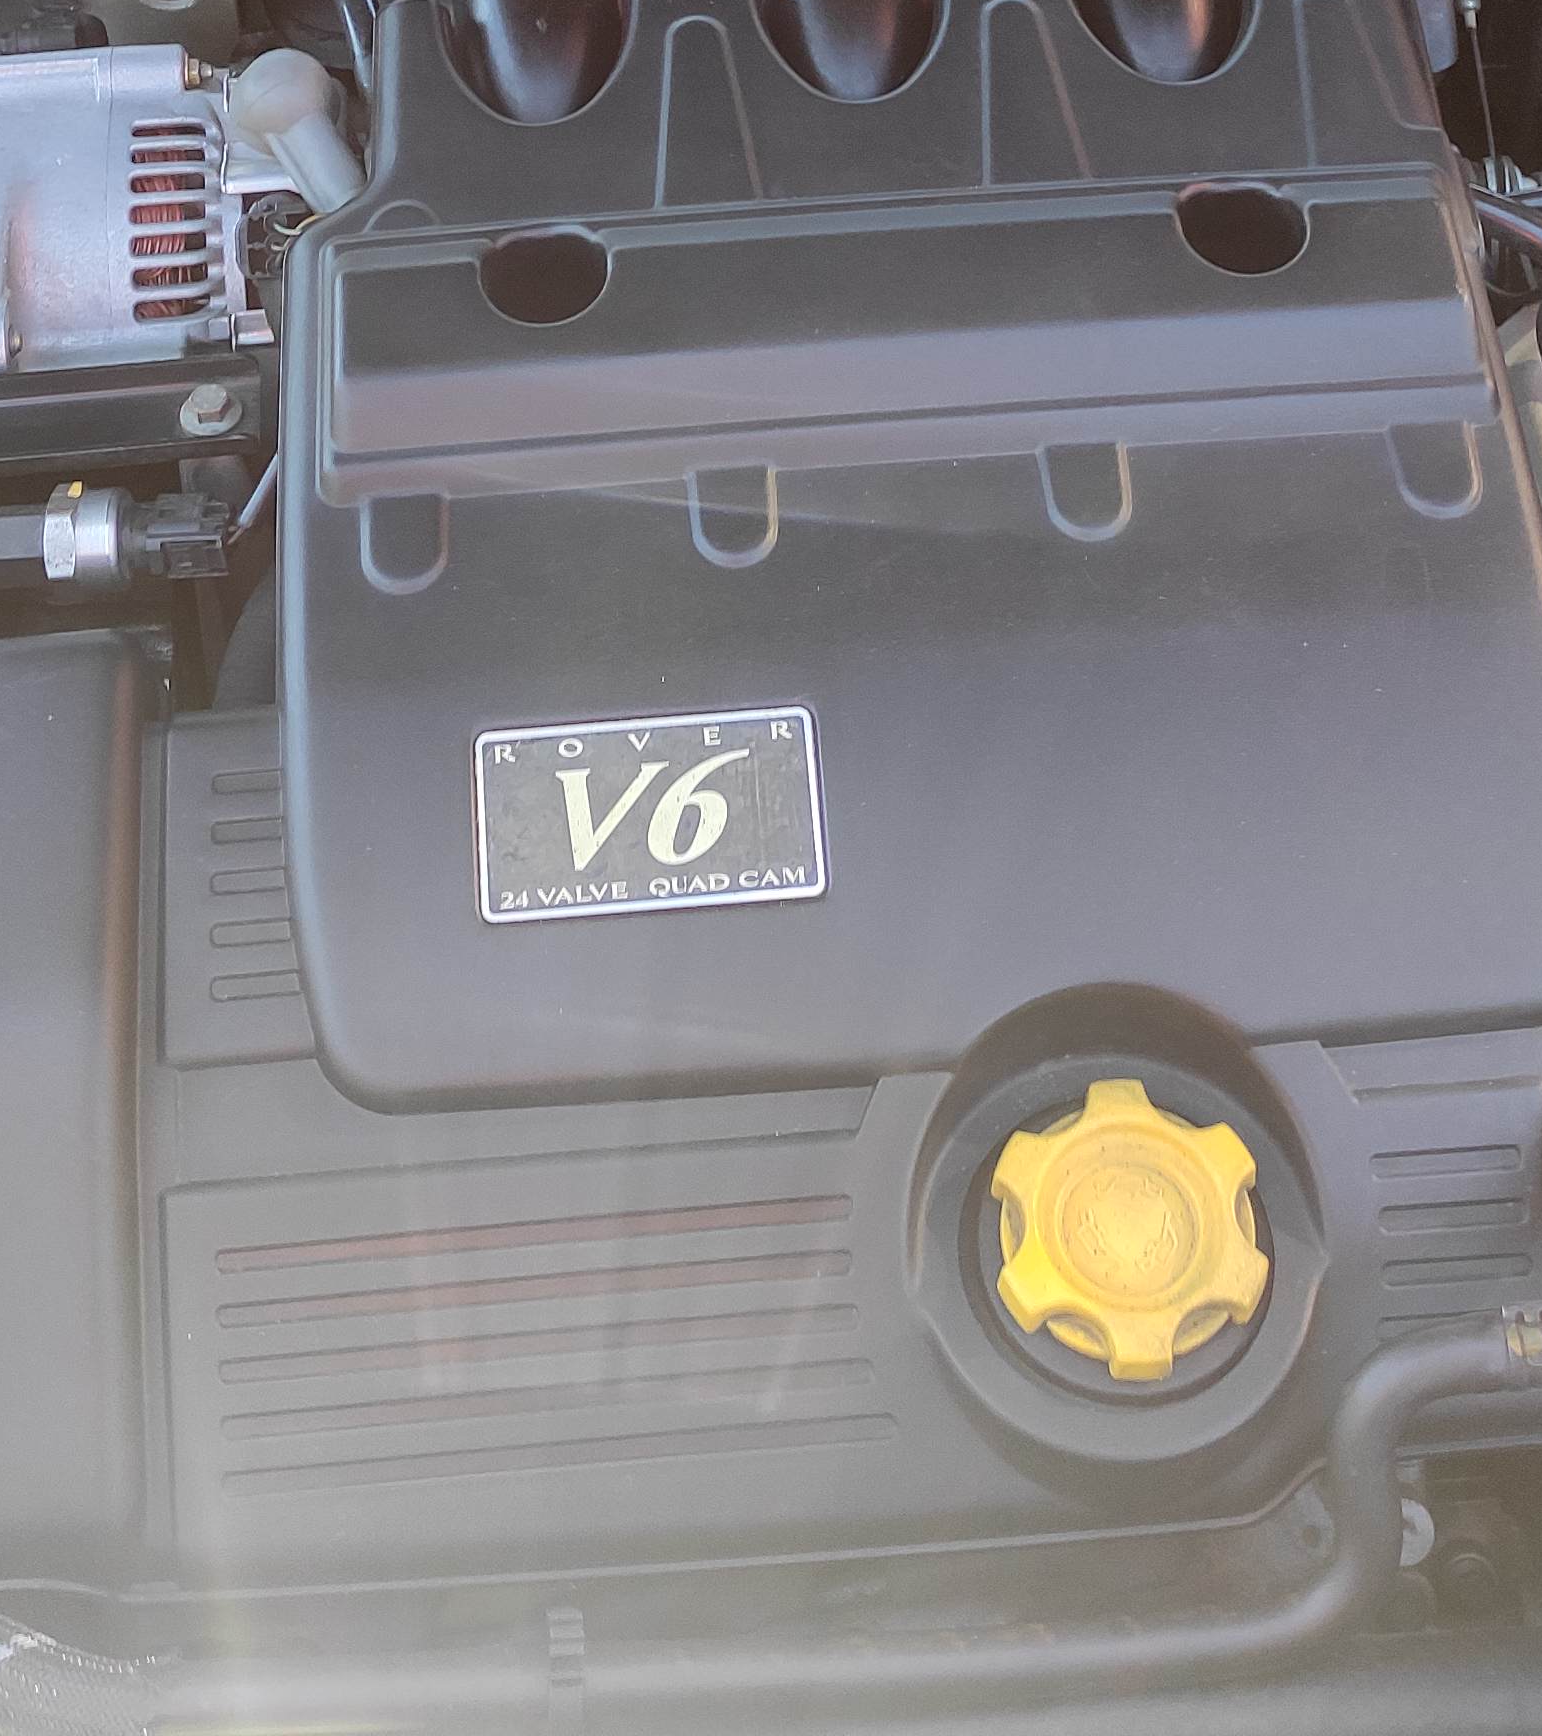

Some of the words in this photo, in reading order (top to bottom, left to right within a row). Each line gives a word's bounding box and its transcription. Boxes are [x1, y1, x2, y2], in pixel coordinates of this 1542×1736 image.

[493, 719, 793, 765] ROVER
[555, 747, 750, 872] V6
[499, 890, 529, 911] 24
[537, 880, 628, 907] VALVE
[648, 872, 731, 897] QUAD
[738, 864, 807, 889] CAM
